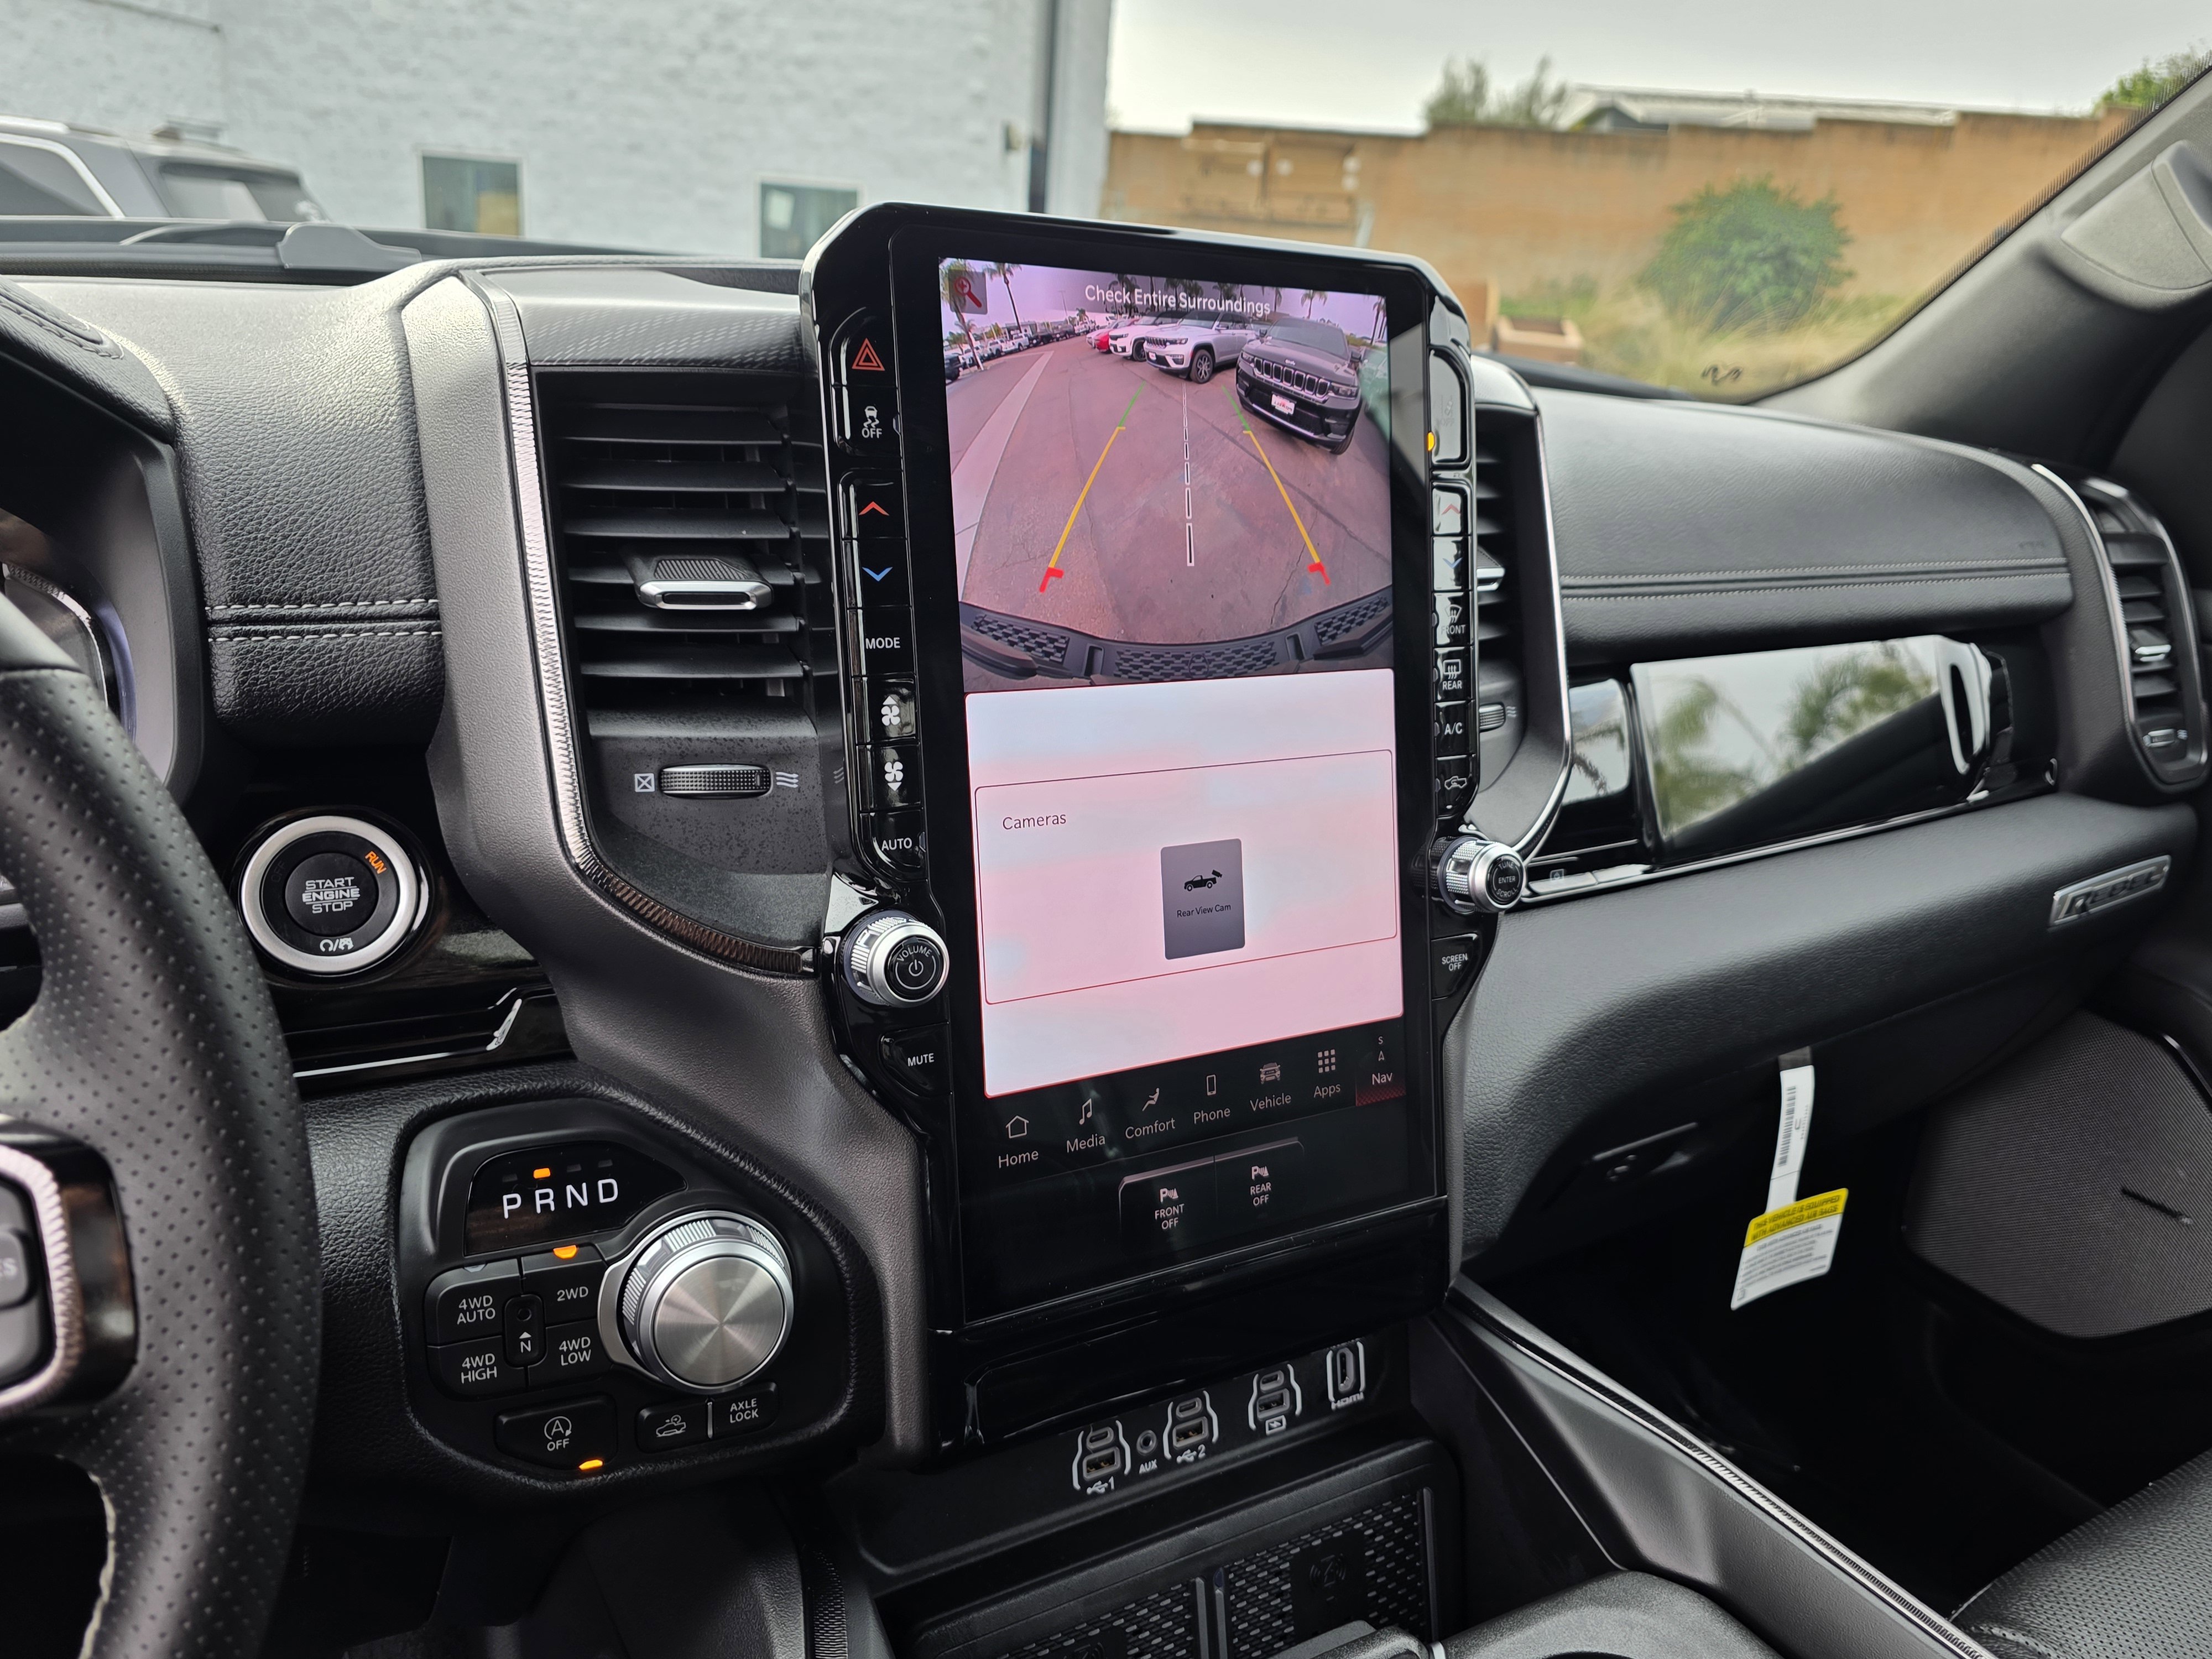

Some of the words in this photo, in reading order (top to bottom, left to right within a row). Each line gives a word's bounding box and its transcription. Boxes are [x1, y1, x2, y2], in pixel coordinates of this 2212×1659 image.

[1085, 284, 1131, 303] Check
[1134, 288, 1176, 308] Entire
[1179, 292, 1271, 318] Surroundings
[861, 427, 883, 439] OFF
[1441, 624, 1466, 634] FRONT
[865, 637, 901, 649] MODE
[1442, 680, 1462, 690] REAR
[1444, 722, 1463, 735] A/C
[1002, 813, 1067, 830] Cameras
[881, 837, 912, 851] AUTO
[365, 851, 388, 874] RUN
[1498, 860, 1514, 870] TUNE
[305, 877, 354, 890] START
[1498, 875, 1516, 884] ENTER
[302, 888, 361, 902] ENGINE
[1496, 887, 1518, 898] SCROLL
[312, 900, 353, 914] STOP
[1177, 907, 1194, 917] Rear
[1195, 905, 1213, 915] View
[1214, 903, 1232, 912] Cam
[897, 945, 932, 963] VOLUME
[1442, 953, 1468, 964] SCREEN
[1448, 962, 1462, 971] OFF
[1378, 1036, 1383, 1045] S
[907, 1053, 935, 1067] MUTE
[1371, 1072, 1393, 1086] Nav
[1313, 1083, 1341, 1099] Apps
[1250, 1092, 1292, 1112] Vehicle
[1193, 1108, 1231, 1124] Phone
[1125, 1117, 1176, 1139] Comfort
[1066, 1134, 1105, 1153] Media
[998, 1150, 1039, 1168] Home
[1250, 1182, 1271, 1196] REAR
[503, 1193, 522, 1218] P
[535, 1188, 555, 1214] R
[566, 1182, 588, 1208] N
[597, 1178, 618, 1203] D
[1253, 1194, 1269, 1207] OFF
[1155, 1203, 1185, 1219] FRONT
[1161, 1217, 1179, 1230] OFF
[557, 1286, 589, 1302] 2WD
[458, 1295, 493, 1310] 4WD
[457, 1307, 496, 1325] AUTO
[520, 1340, 531, 1353] N
[559, 1336, 591, 1353] 4WD
[461, 1353, 496, 1369] 4WD
[560, 1349, 592, 1366] LOW
[461, 1366, 498, 1384] HIGH
[730, 1398, 758, 1413] AXLE
[729, 1408, 759, 1424] LOCK
[546, 1437, 570, 1452] OFF
[1197, 1444, 1206, 1458] 2
[1139, 1459, 1158, 1474] AUX
[1108, 1476, 1114, 1490] 1
